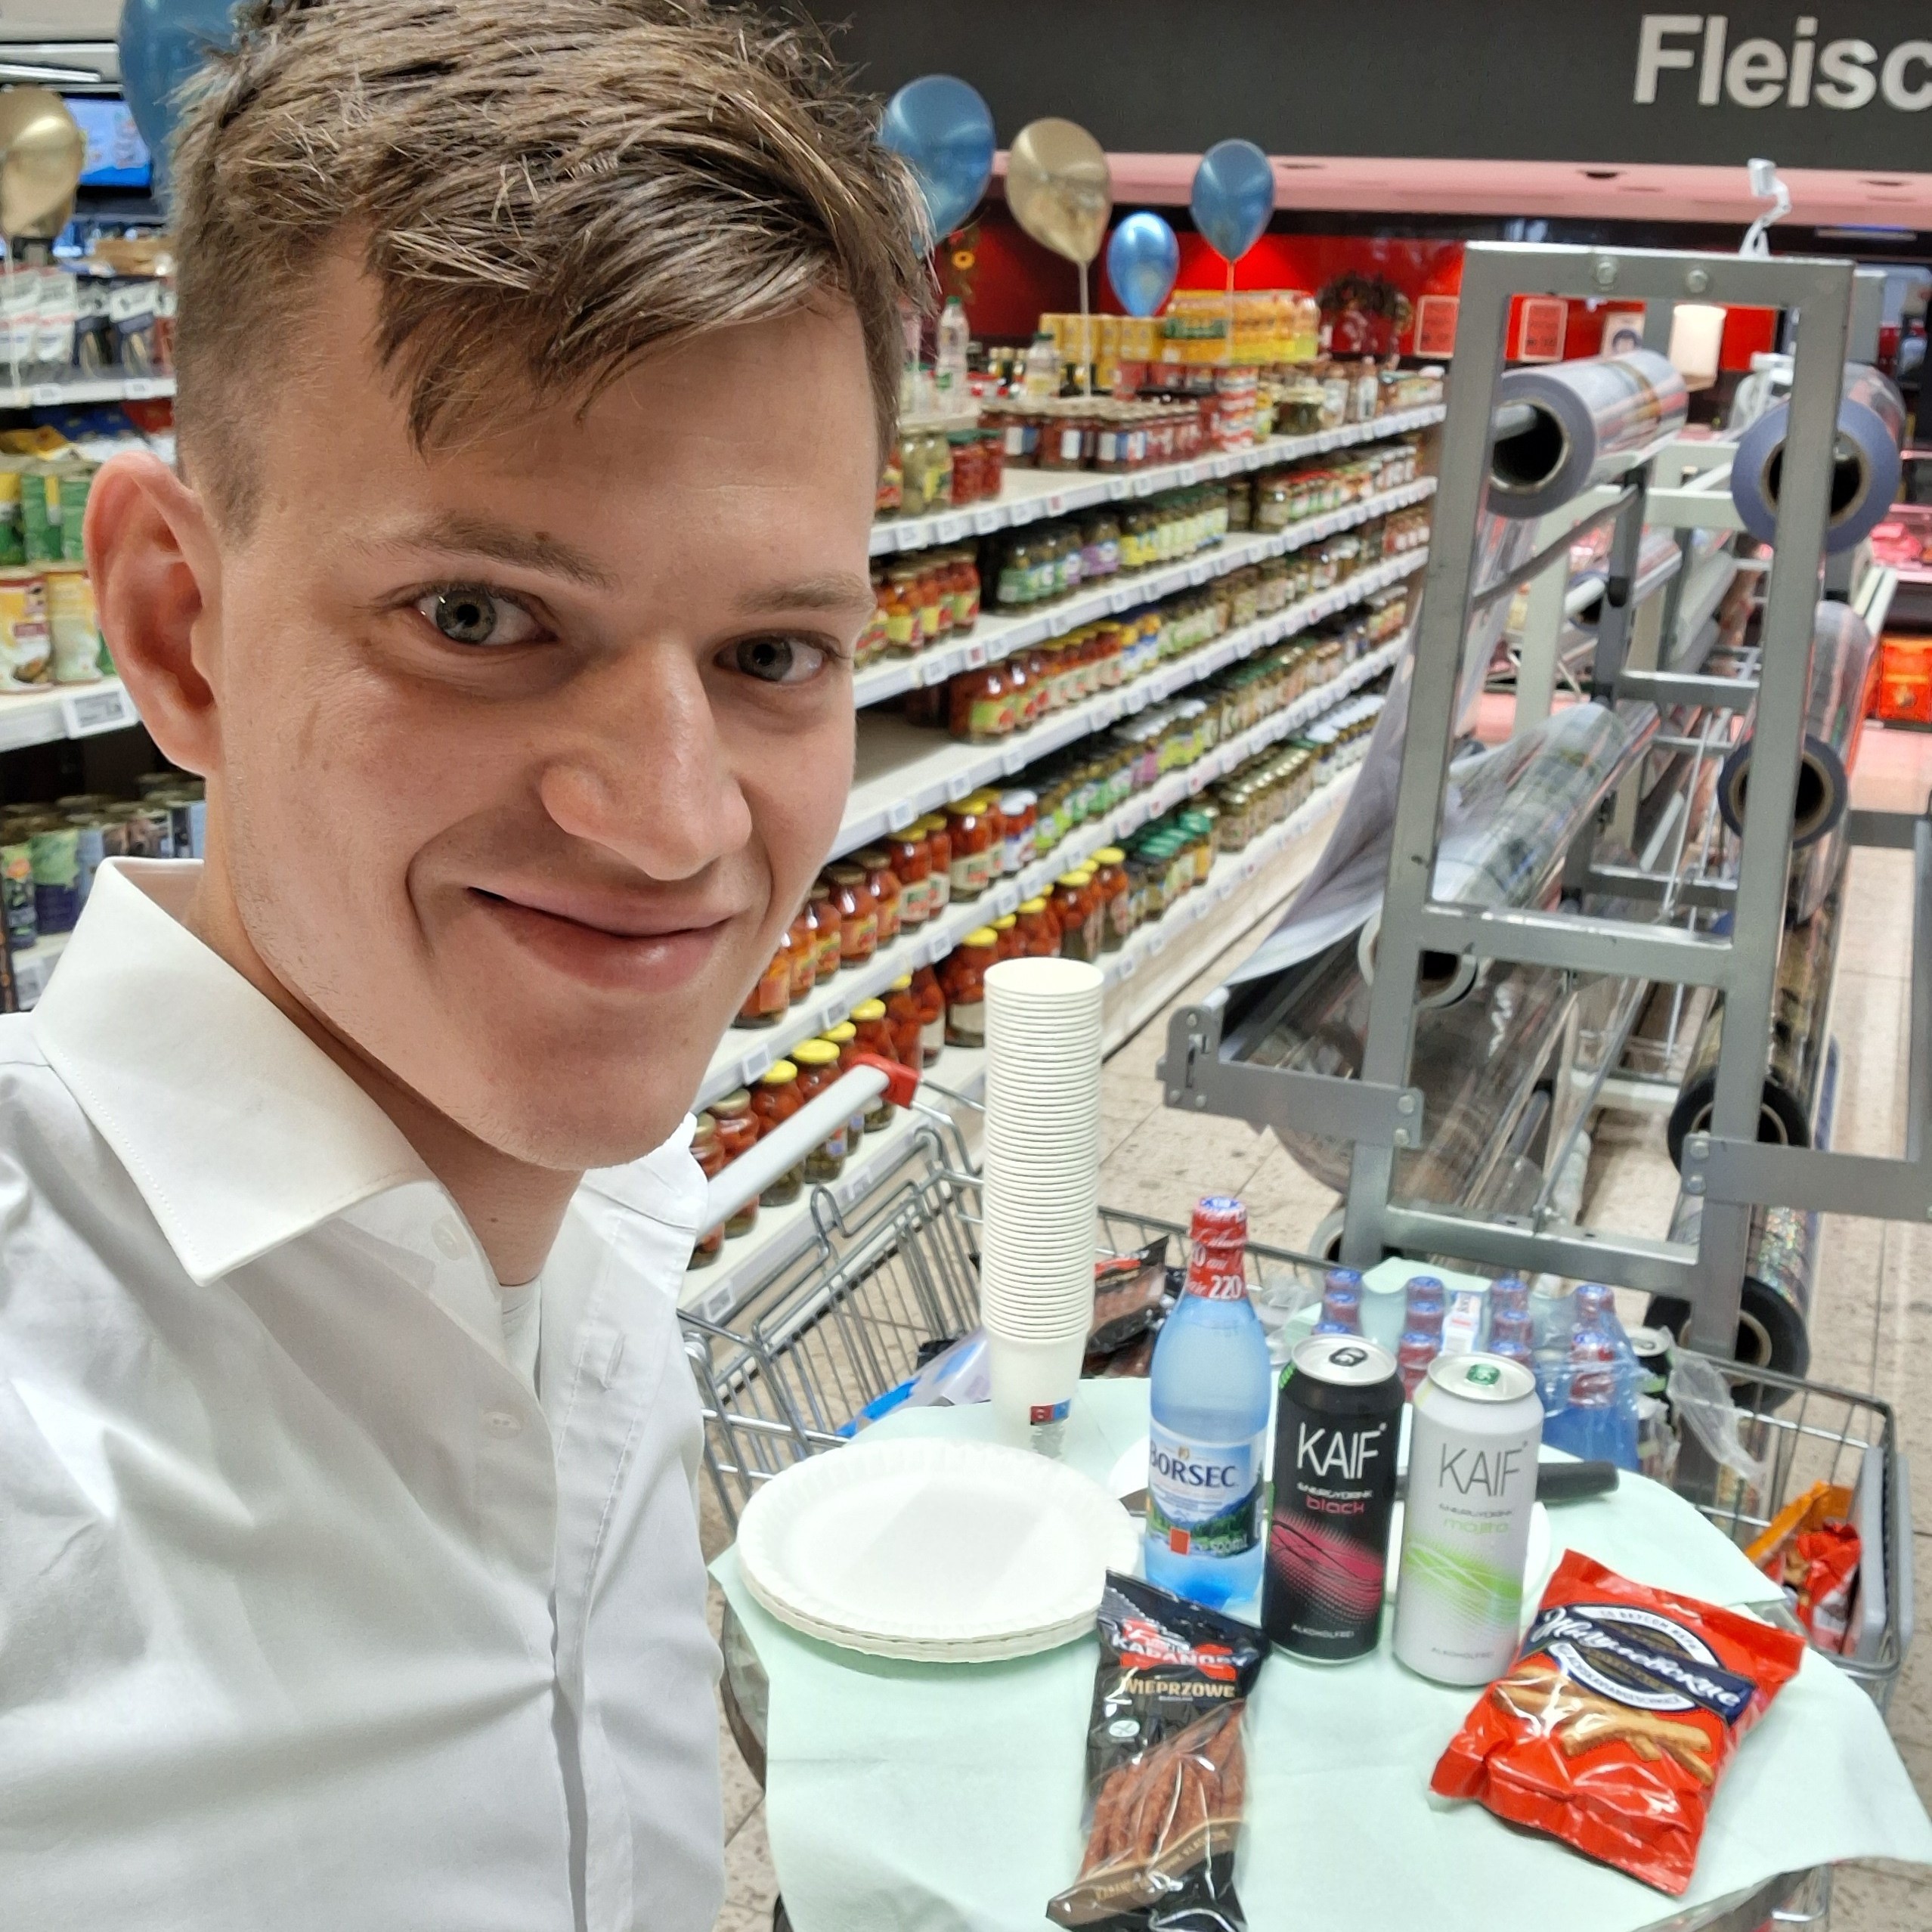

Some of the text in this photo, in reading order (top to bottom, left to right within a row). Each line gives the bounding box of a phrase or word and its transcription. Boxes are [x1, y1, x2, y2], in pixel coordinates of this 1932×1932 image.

[1633, 14, 1932, 111] Fleisc
[1209, 1275, 1242, 1299] 220
[1150, 1439, 1237, 1488] BORSEC
[1297, 1423, 1382, 1479] KAIF
[1439, 1444, 1522, 1497] KAIF
[1306, 1495, 1365, 1515] black
